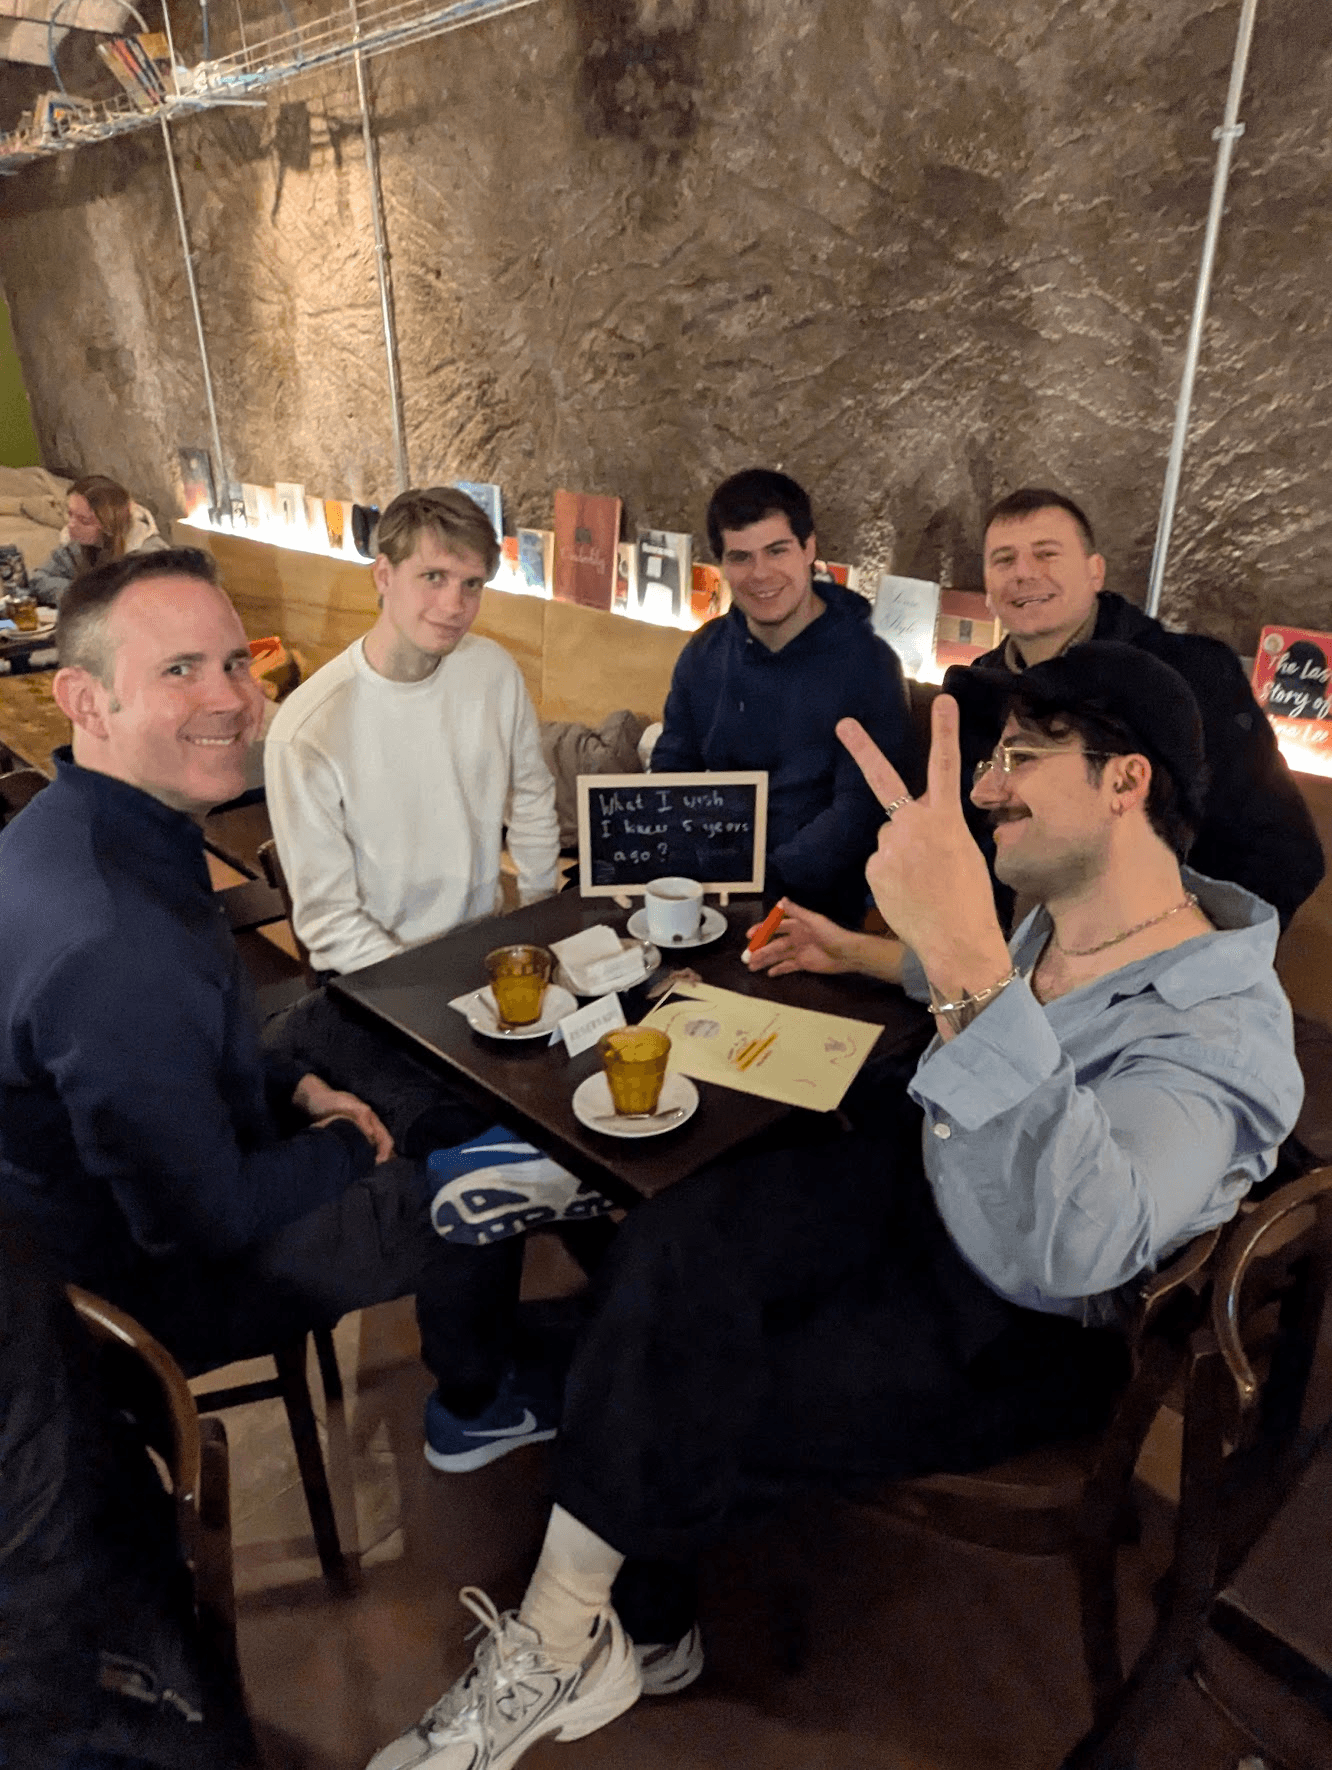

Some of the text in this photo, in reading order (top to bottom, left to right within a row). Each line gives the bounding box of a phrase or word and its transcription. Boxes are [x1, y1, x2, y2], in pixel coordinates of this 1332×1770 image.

[1267, 651, 1332, 684] The Las
[1259, 681, 1312, 718] Story
[599, 791, 645, 816] What
[655, 789, 673, 813] I
[601, 819, 749, 839] I knew 5 years
